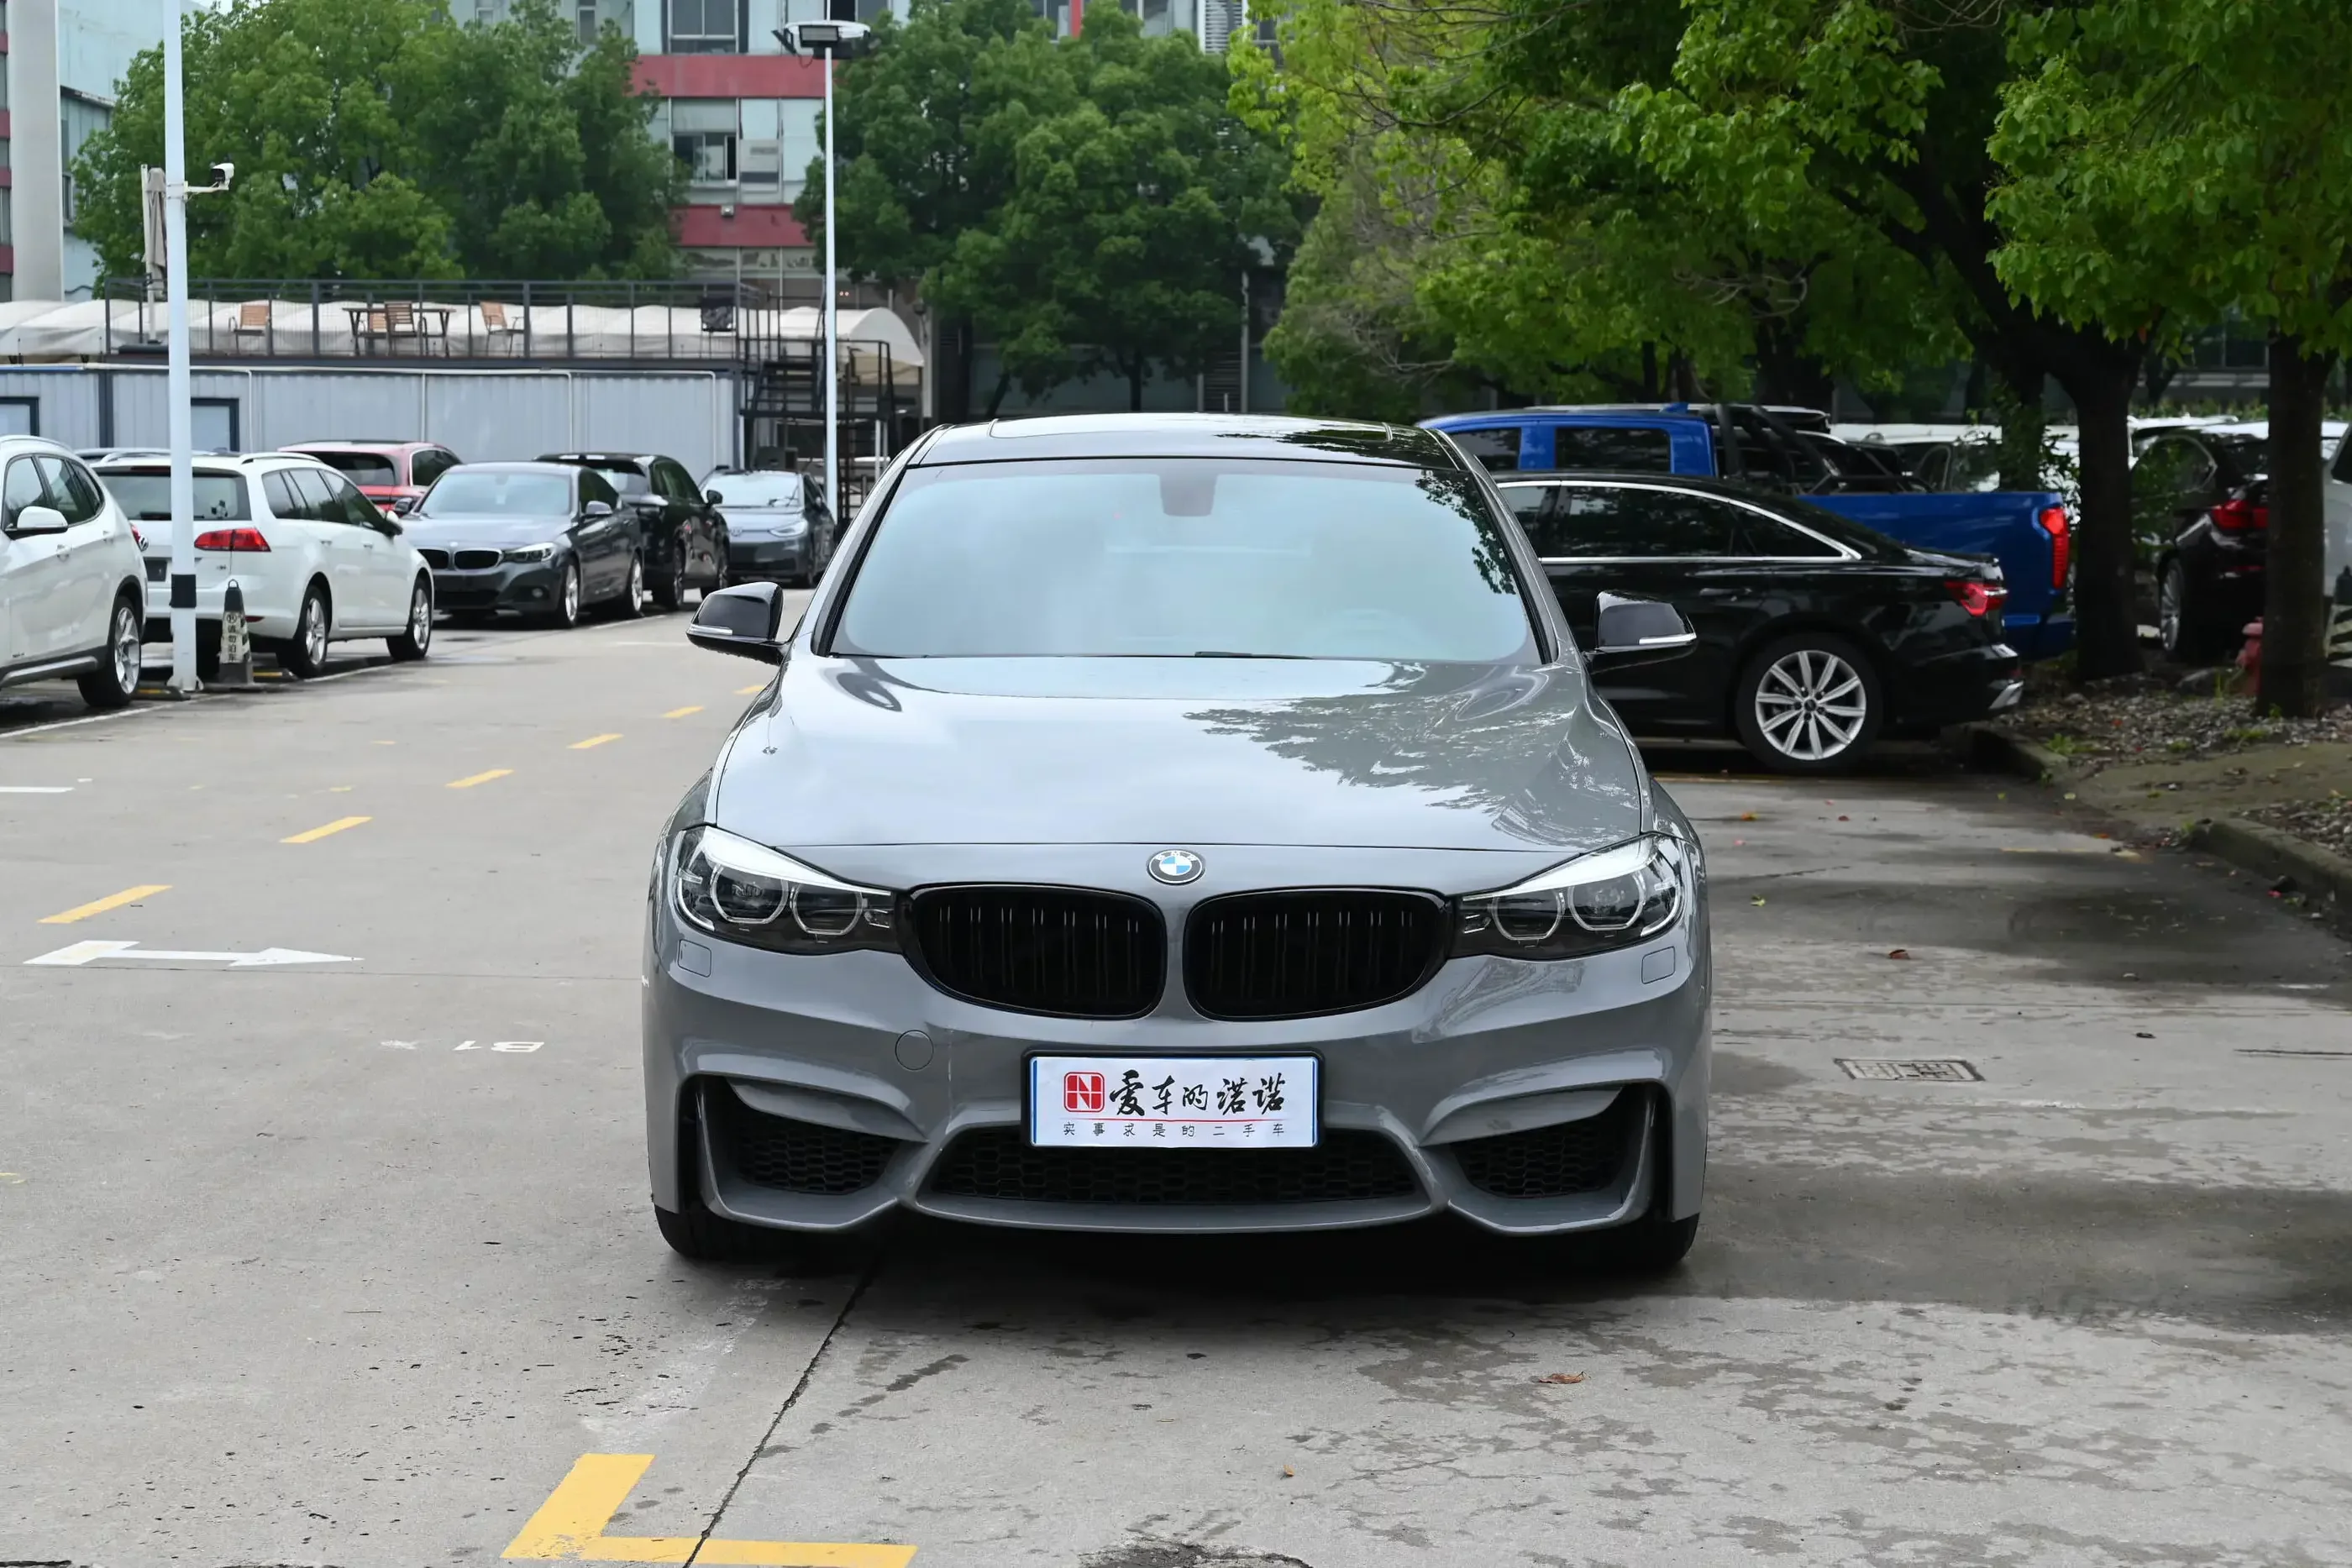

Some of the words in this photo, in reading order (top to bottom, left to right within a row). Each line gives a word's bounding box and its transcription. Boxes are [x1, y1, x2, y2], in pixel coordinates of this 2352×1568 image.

[1063, 1122, 1284, 1137] 实事求是的二手车
